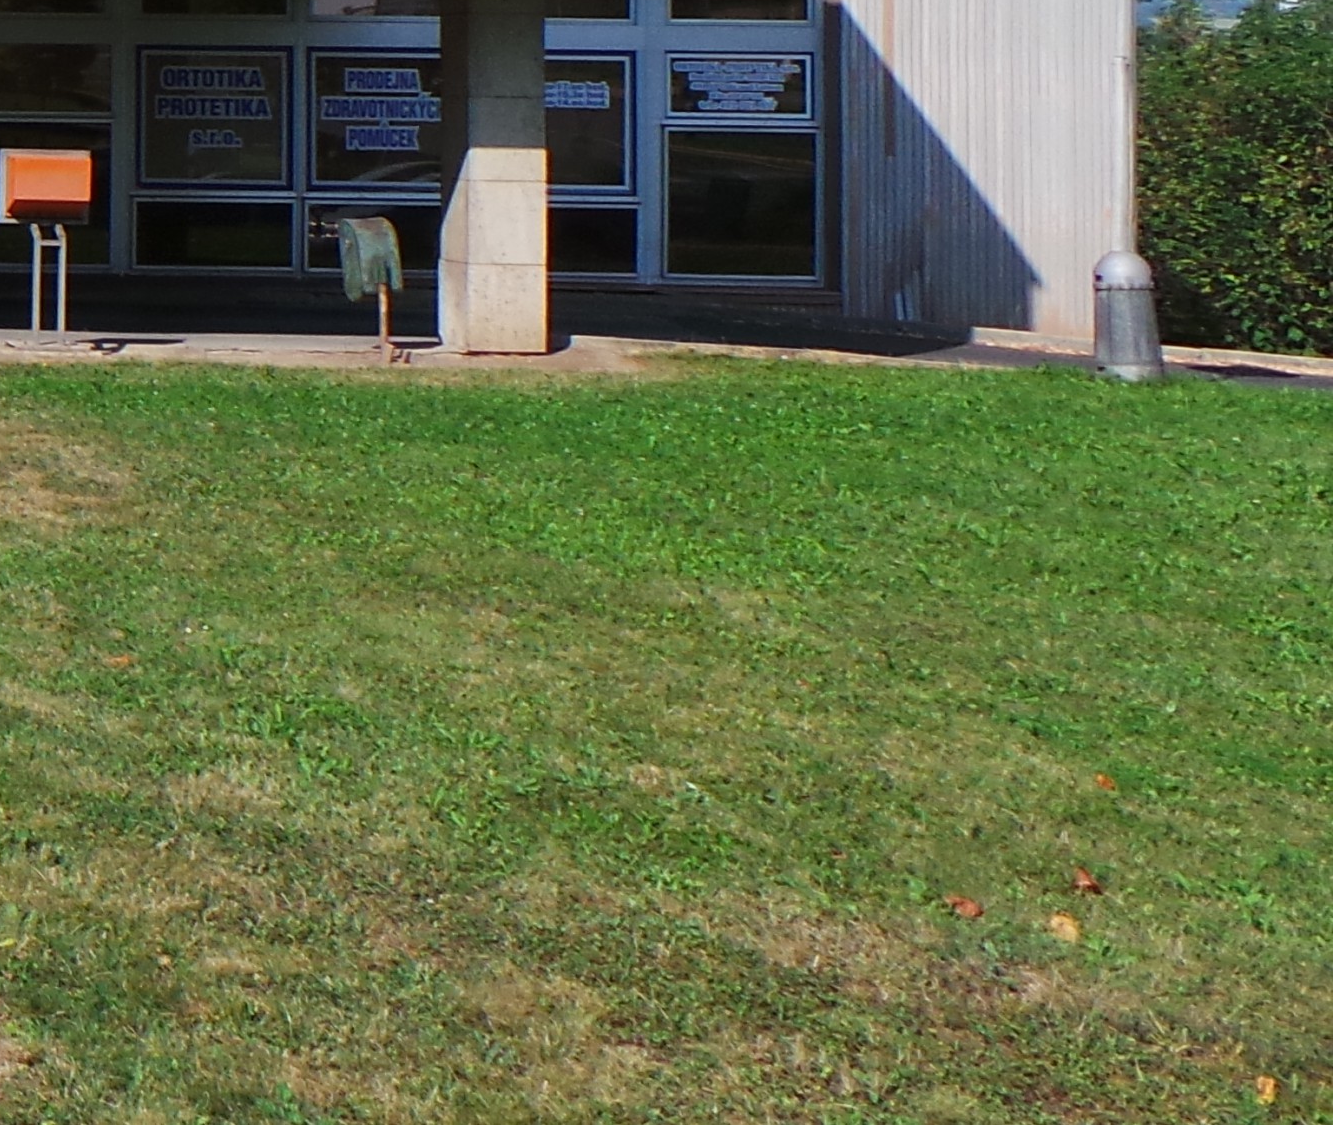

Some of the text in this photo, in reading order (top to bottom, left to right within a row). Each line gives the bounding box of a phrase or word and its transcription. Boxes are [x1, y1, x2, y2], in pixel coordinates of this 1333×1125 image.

[162, 68, 263, 88] ORTOTIKA
[347, 70, 418, 89] PRODEJNA
[157, 97, 269, 117] PROTETIKA
[192, 130, 242, 146] s.r.o.
